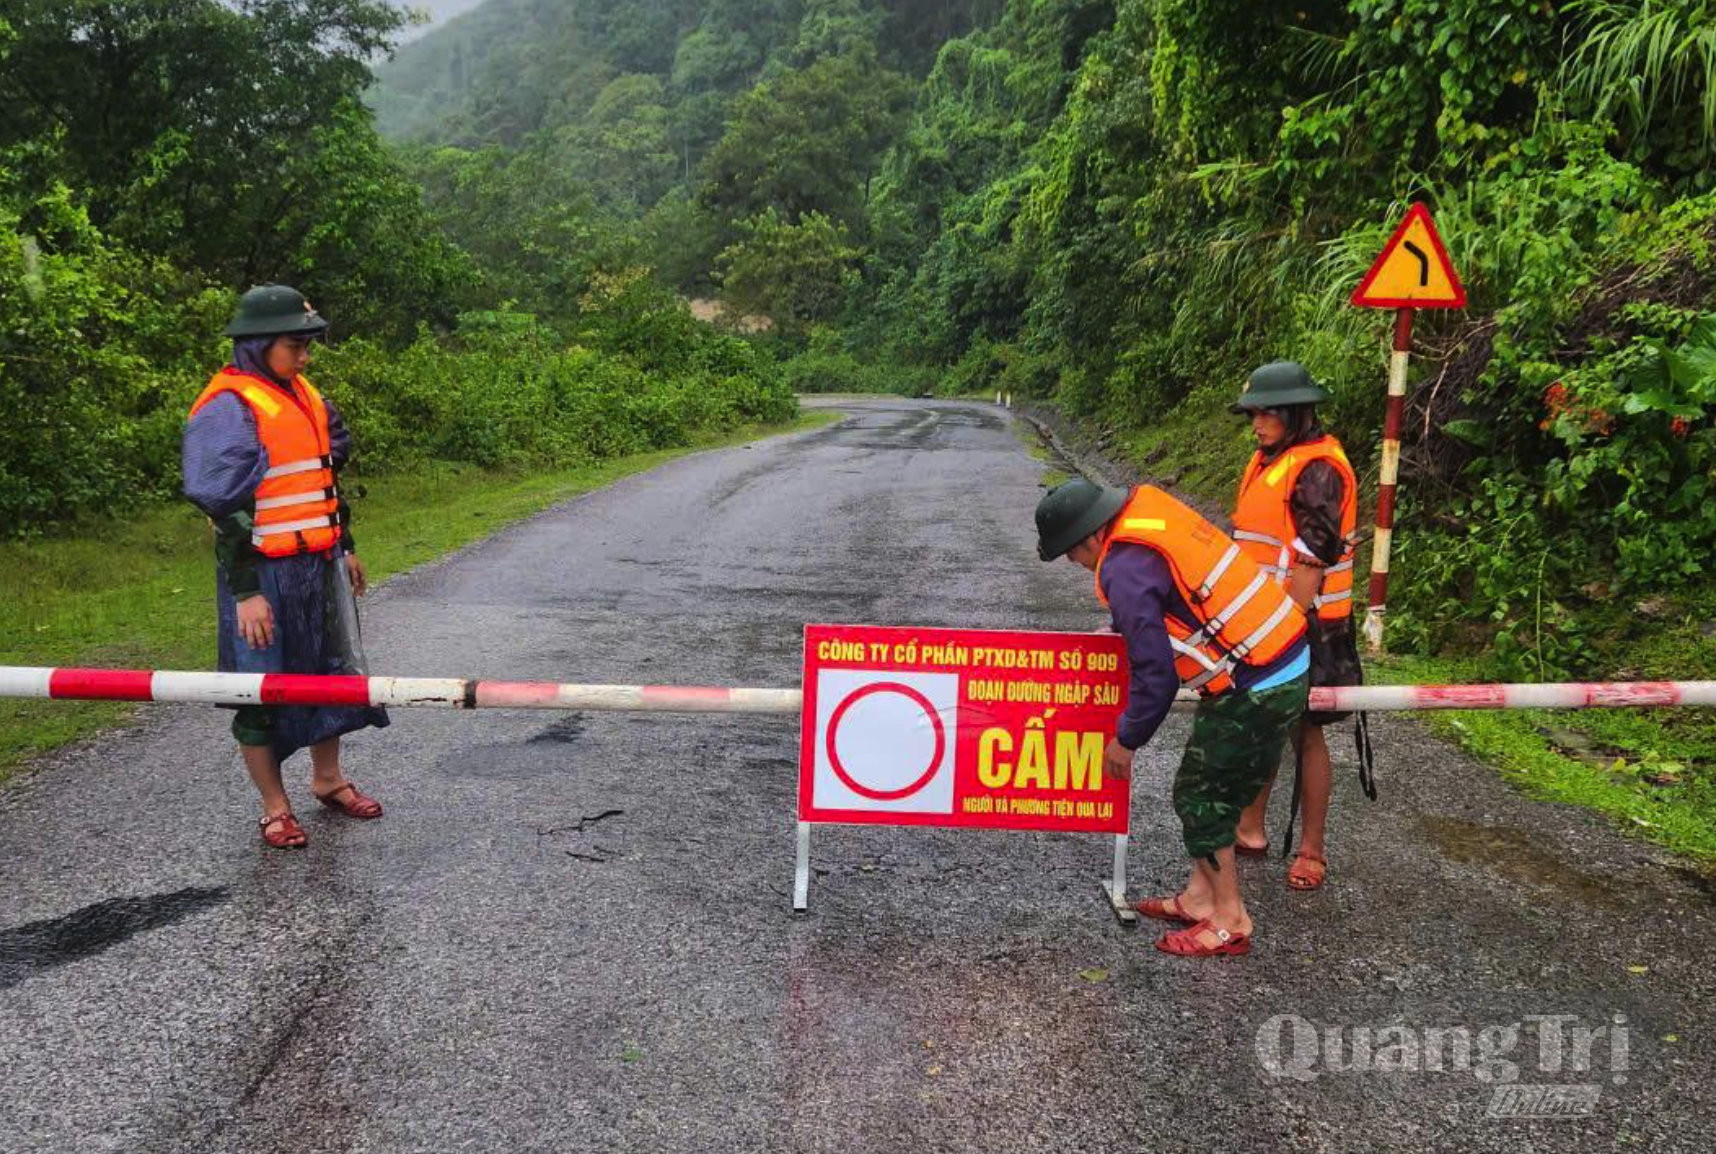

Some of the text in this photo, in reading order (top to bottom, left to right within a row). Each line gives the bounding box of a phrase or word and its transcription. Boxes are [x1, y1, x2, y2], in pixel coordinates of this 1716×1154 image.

[818, 638, 865, 661] CÔNG
[870, 643, 889, 662] TY
[972, 648, 1054, 669] PTXD&TM
[1059, 645, 1082, 670] SỐ
[1087, 652, 1118, 671] 909
[1094, 681, 1119, 705] SÂU
[978, 708, 1104, 790] CẤM
[1076, 802, 1095, 818] QUA
